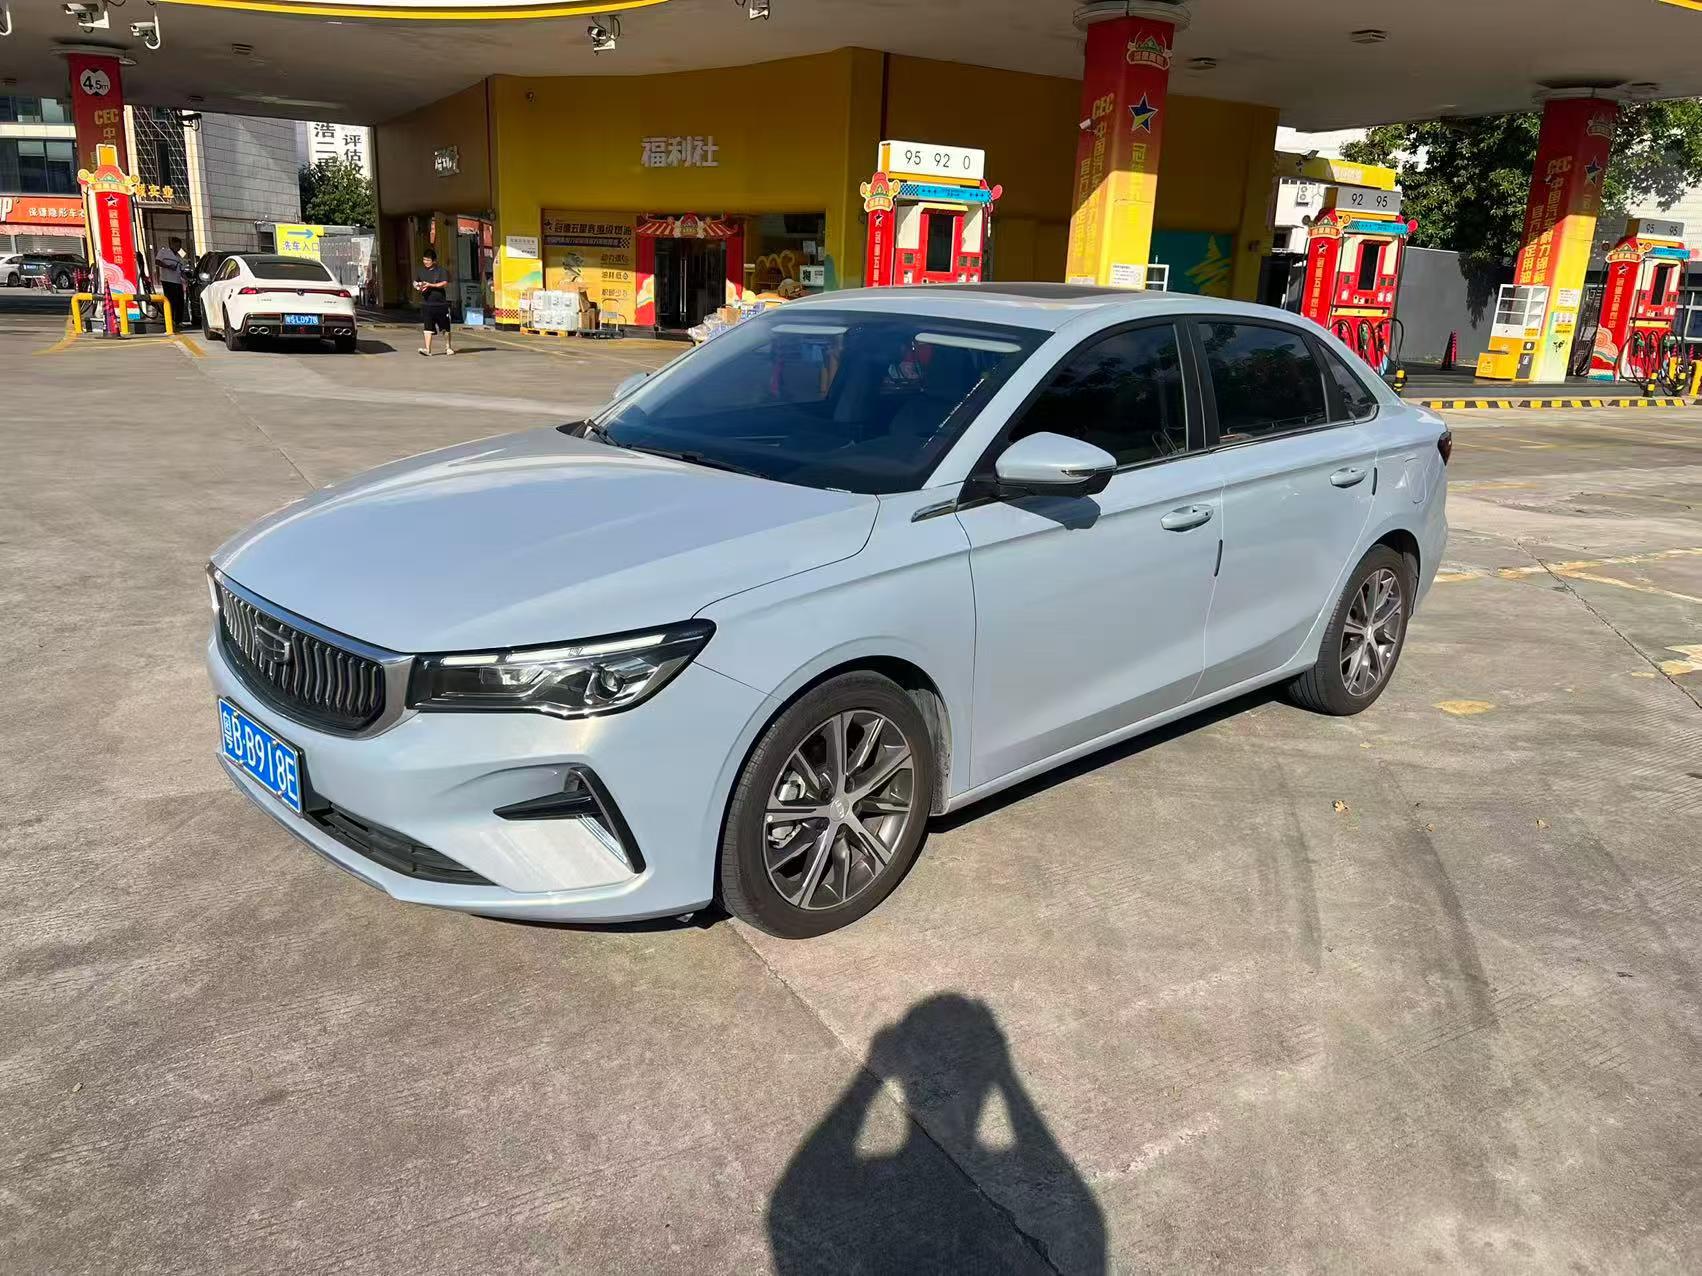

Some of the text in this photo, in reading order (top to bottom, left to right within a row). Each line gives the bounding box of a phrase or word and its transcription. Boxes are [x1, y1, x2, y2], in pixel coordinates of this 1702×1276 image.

[83, 76, 109, 90] 4.5m
[95, 109, 119, 125] CEC
[641, 136, 719, 168] 福利社
[905, 150, 971, 170] 95 92 0
[1351, 193, 1388, 208] 92 95
[1646, 223, 1678, 236] 95 95
[283, 241, 320, 251] 洗车入口
